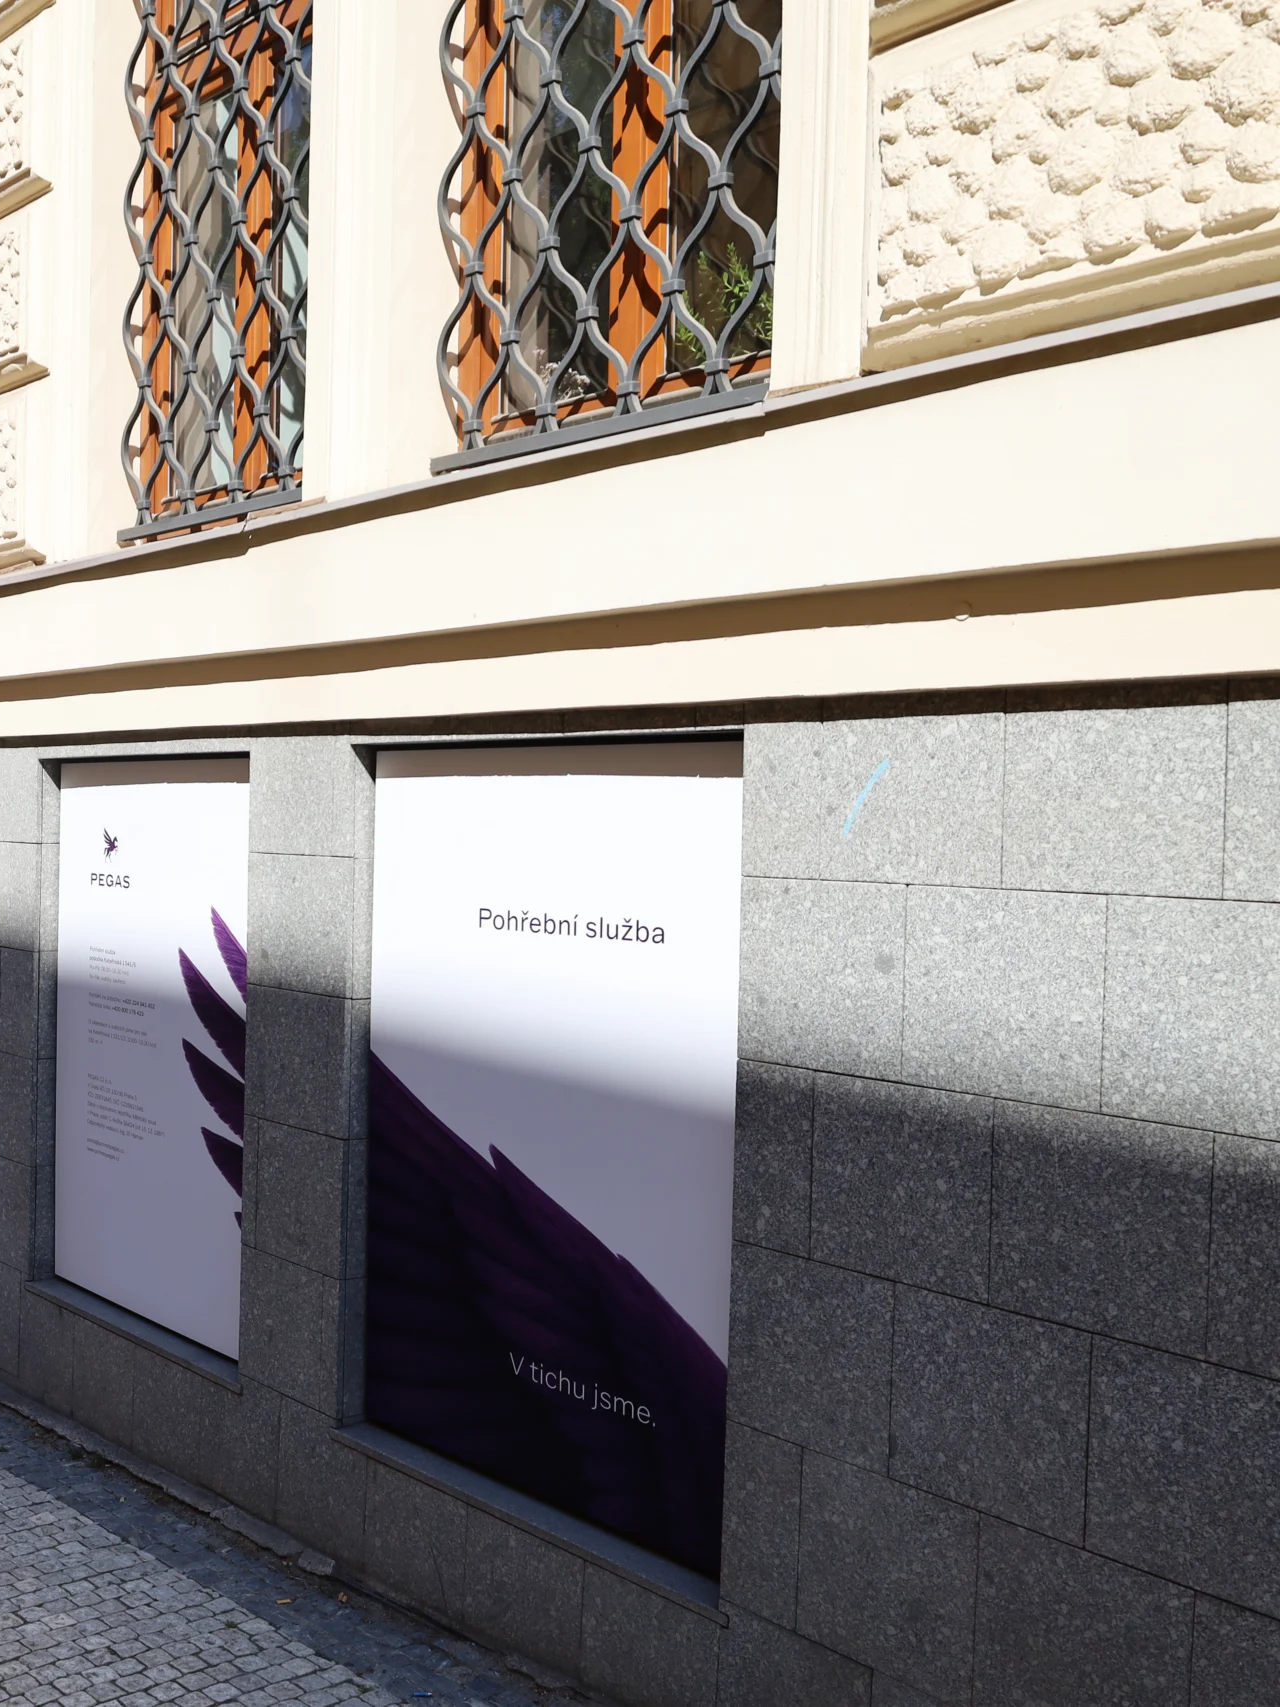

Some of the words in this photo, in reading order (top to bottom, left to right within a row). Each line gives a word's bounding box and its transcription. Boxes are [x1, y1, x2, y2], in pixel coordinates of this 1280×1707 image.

[90, 872, 131, 889] PEGAS
[478, 907, 580, 936] Pohřební
[585, 916, 666, 944] služba
[509, 1351, 525, 1376] V
[529, 1361, 586, 1401] tichu
[591, 1382, 656, 1428] jsme.
